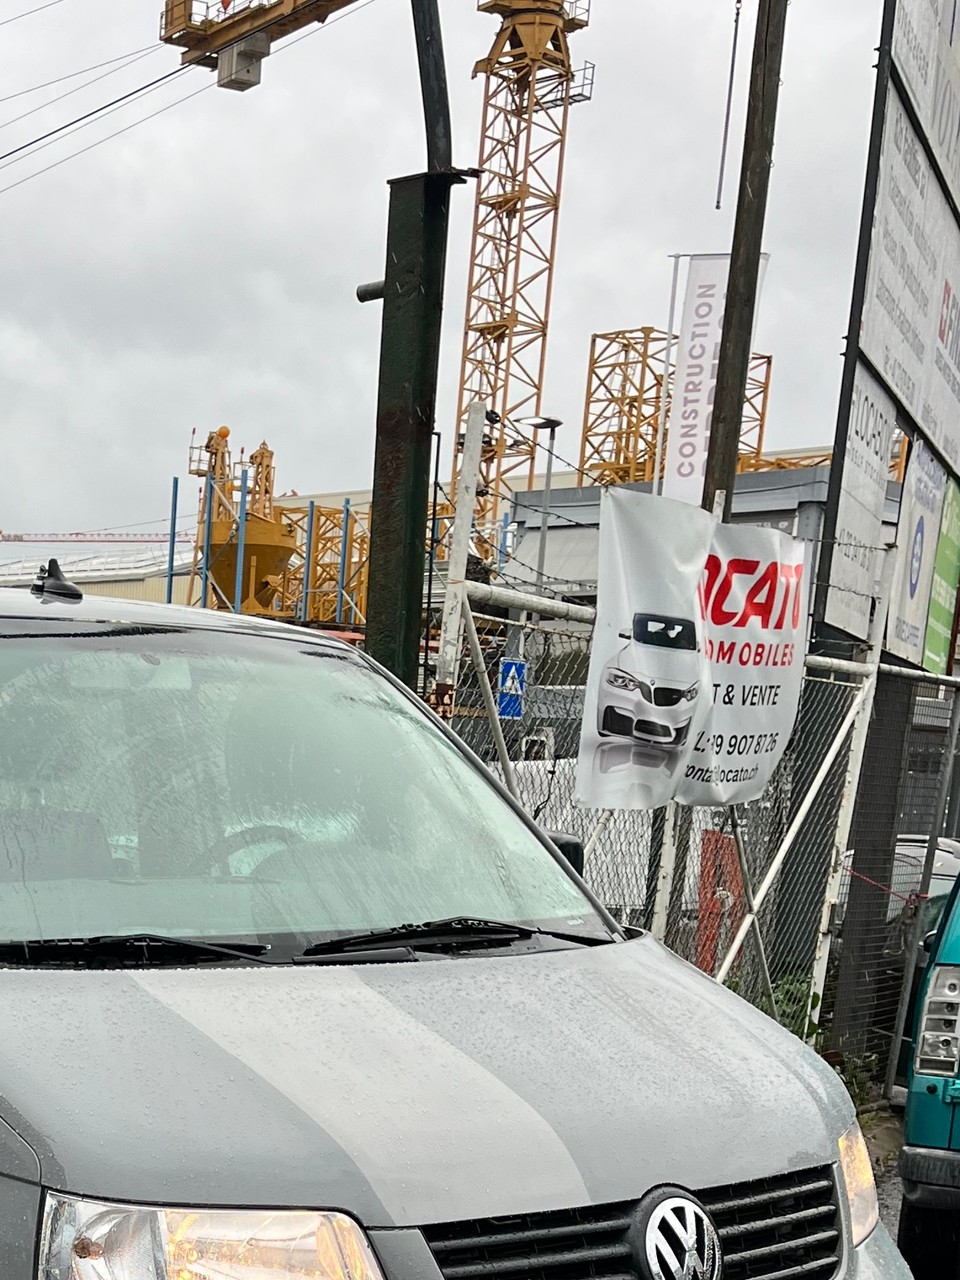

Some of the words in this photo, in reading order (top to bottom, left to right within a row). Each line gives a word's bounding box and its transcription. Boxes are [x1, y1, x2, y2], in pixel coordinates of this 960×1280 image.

[676, 283, 717, 478] CONSTRUCTION
[722, 684, 735, 706] &
[741, 685, 781, 706] VENTE
